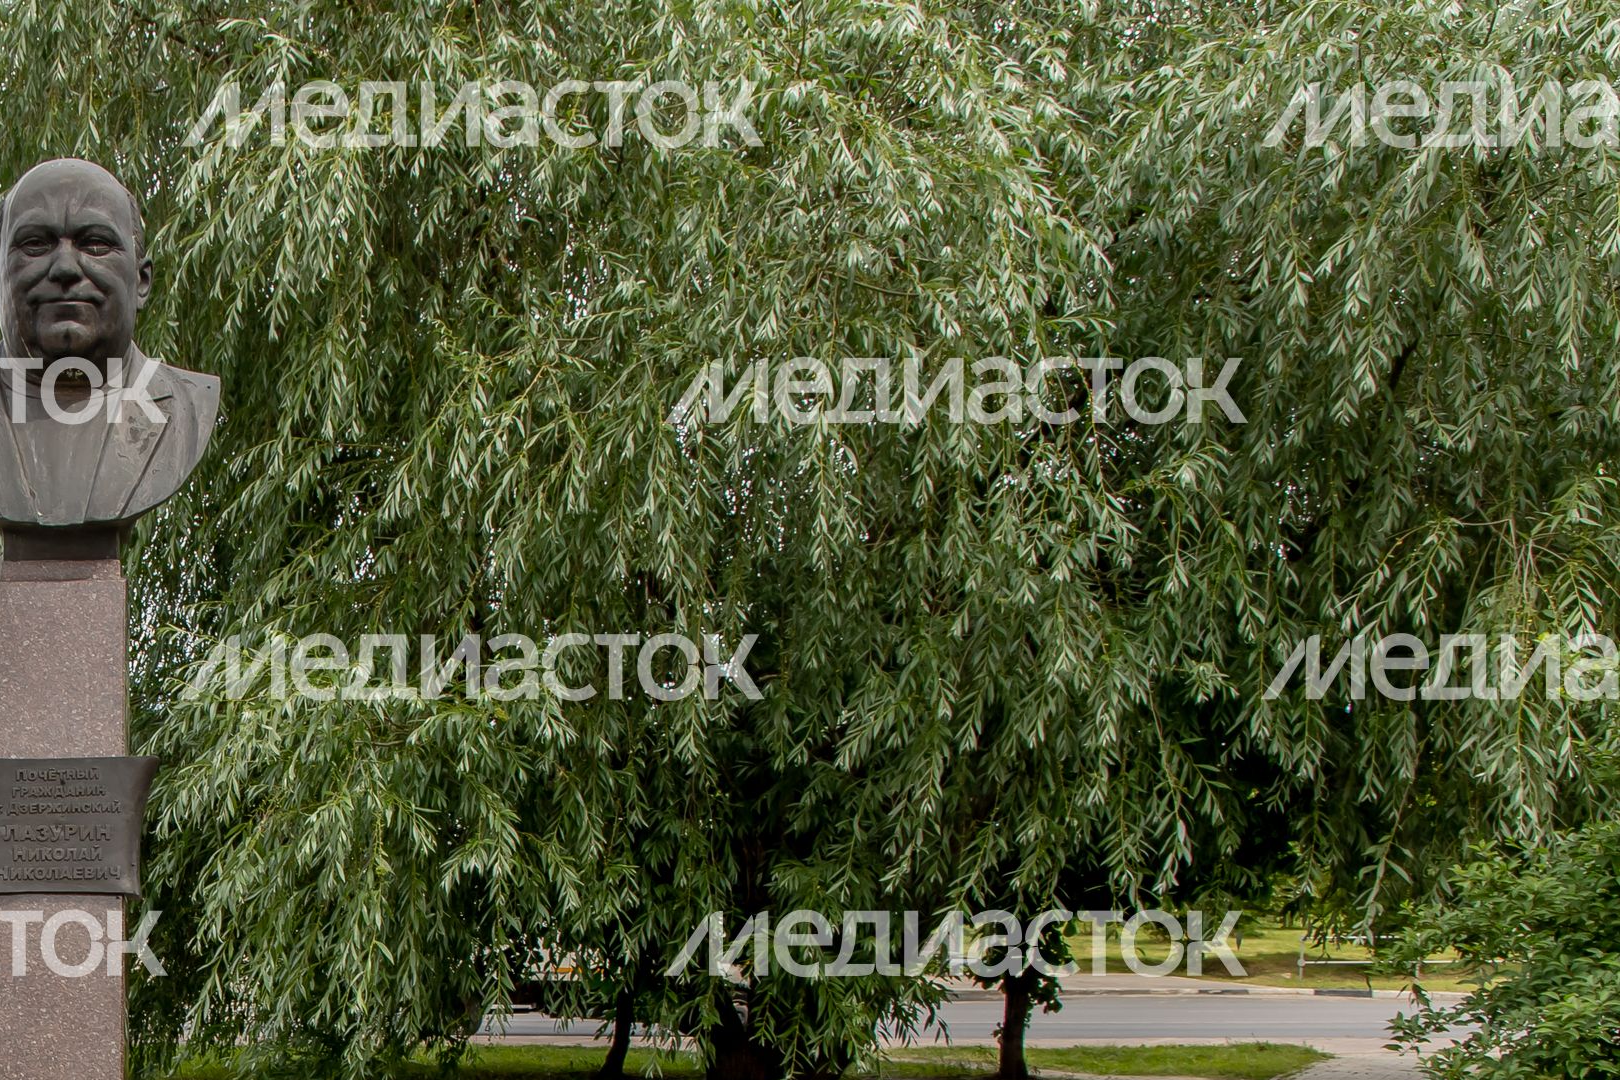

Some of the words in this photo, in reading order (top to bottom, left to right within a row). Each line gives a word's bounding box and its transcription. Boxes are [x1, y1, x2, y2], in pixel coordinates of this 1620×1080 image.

[15, 767, 100, 782] ПОЧЁТНЫЙ
[11, 785, 106, 799] ГРАЖДАНИН
[7, 800, 121, 816] ДЗЕРЖИНСКИЙ
[2, 824, 111, 842] ЛАЗУРИН
[12, 844, 102, 862] НИКОЛАЙ
